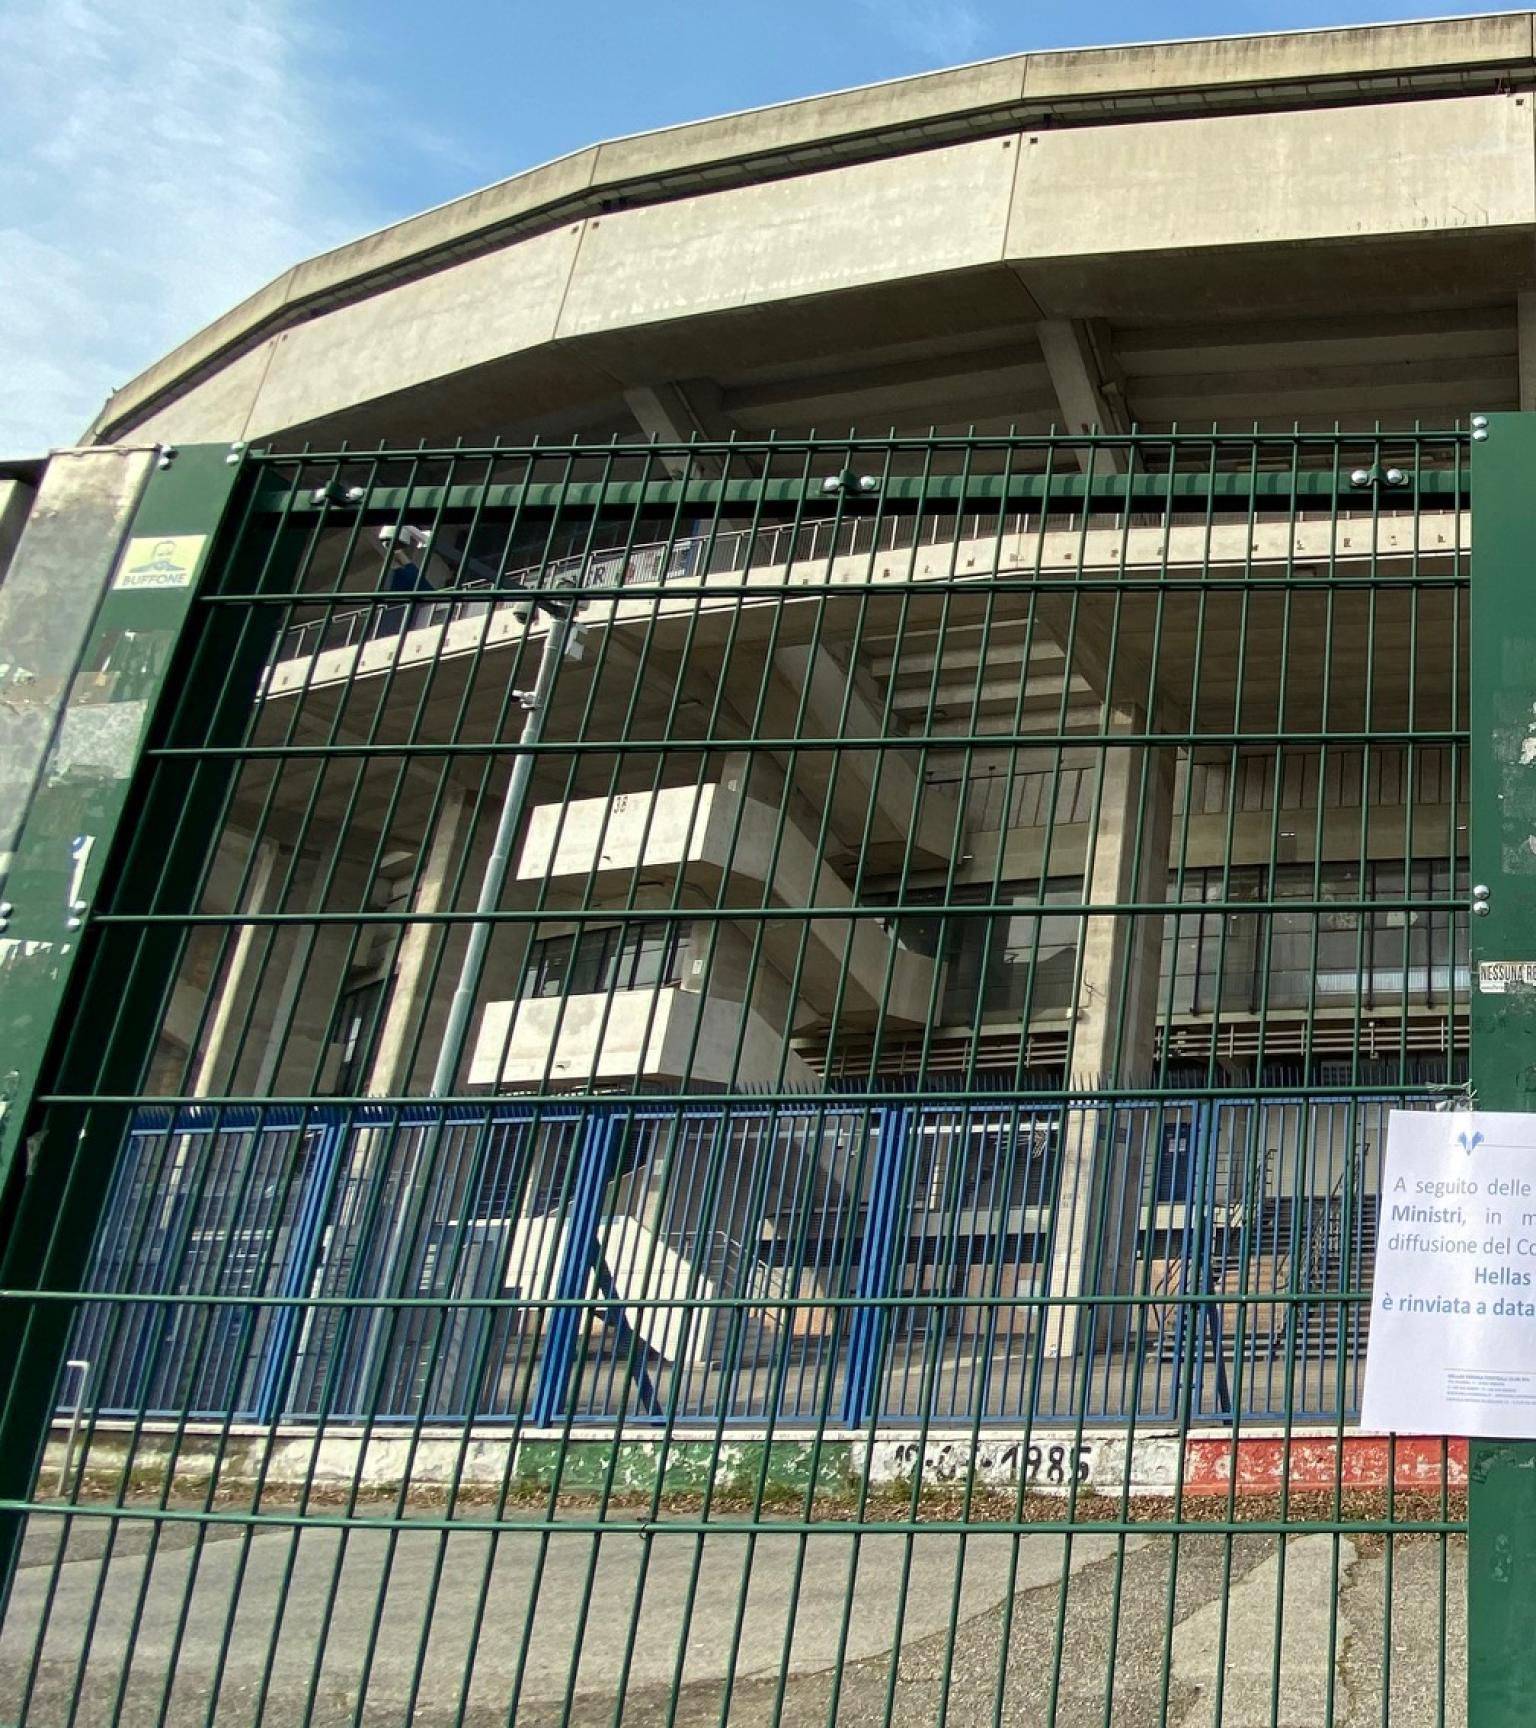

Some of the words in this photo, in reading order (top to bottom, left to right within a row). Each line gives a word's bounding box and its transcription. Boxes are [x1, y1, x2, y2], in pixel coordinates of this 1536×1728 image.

[122, 573, 187, 586] BUFFONE
[1480, 965, 1523, 981] NESSUNA
[1393, 1176, 1407, 1193] A
[1415, 1177, 1478, 1198] seguito
[1487, 1177, 1532, 1197] delle
[1391, 1204, 1467, 1226] Ministri,
[1485, 1207, 1502, 1225] in
[1387, 1233, 1478, 1253] diffusione
[1482, 1236, 1511, 1255] del
[1474, 1266, 1532, 1285] Hellas
[1381, 1292, 1393, 1310] è
[1398, 1294, 1471, 1314] rinviata
[1476, 1302, 1487, 1315] a
[1492, 1298, 1535, 1317] data
